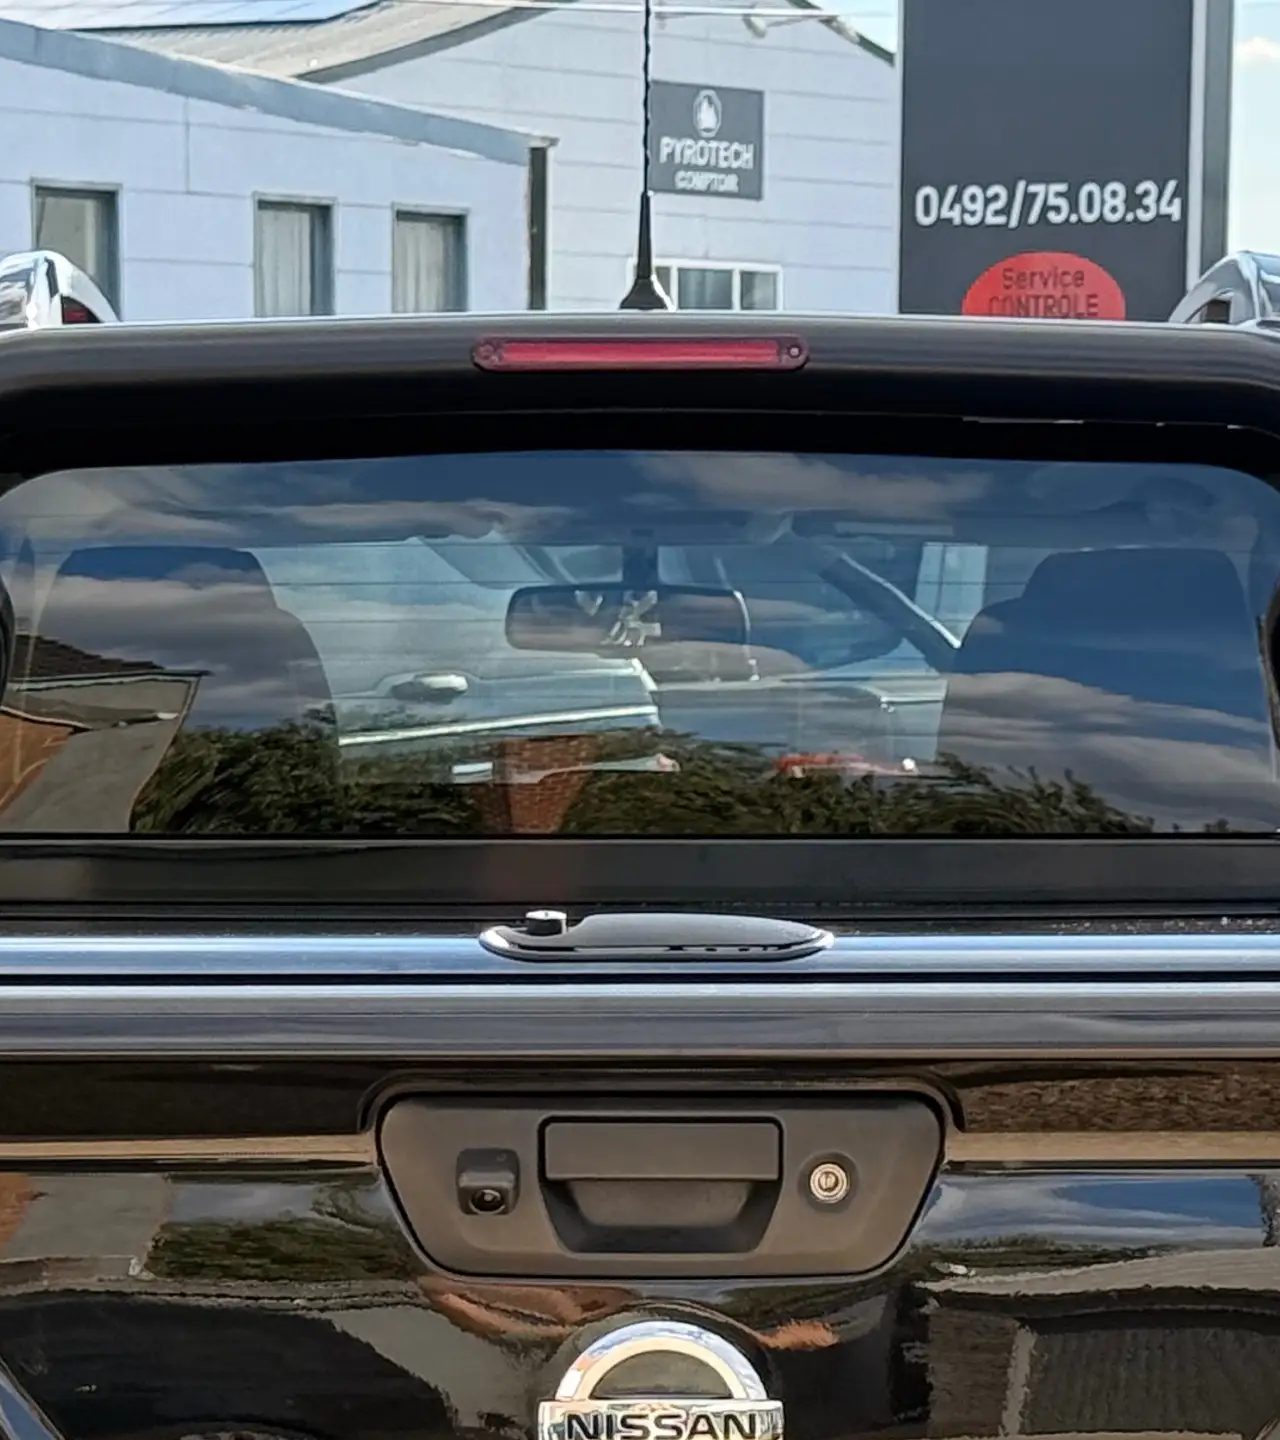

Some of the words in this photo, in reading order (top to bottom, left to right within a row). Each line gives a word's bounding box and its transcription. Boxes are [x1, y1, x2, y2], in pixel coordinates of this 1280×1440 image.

[659, 136, 754, 169] PYROTECH
[915, 179, 1182, 229] 0492/75.08.34
[1003, 265, 1085, 290] Service
